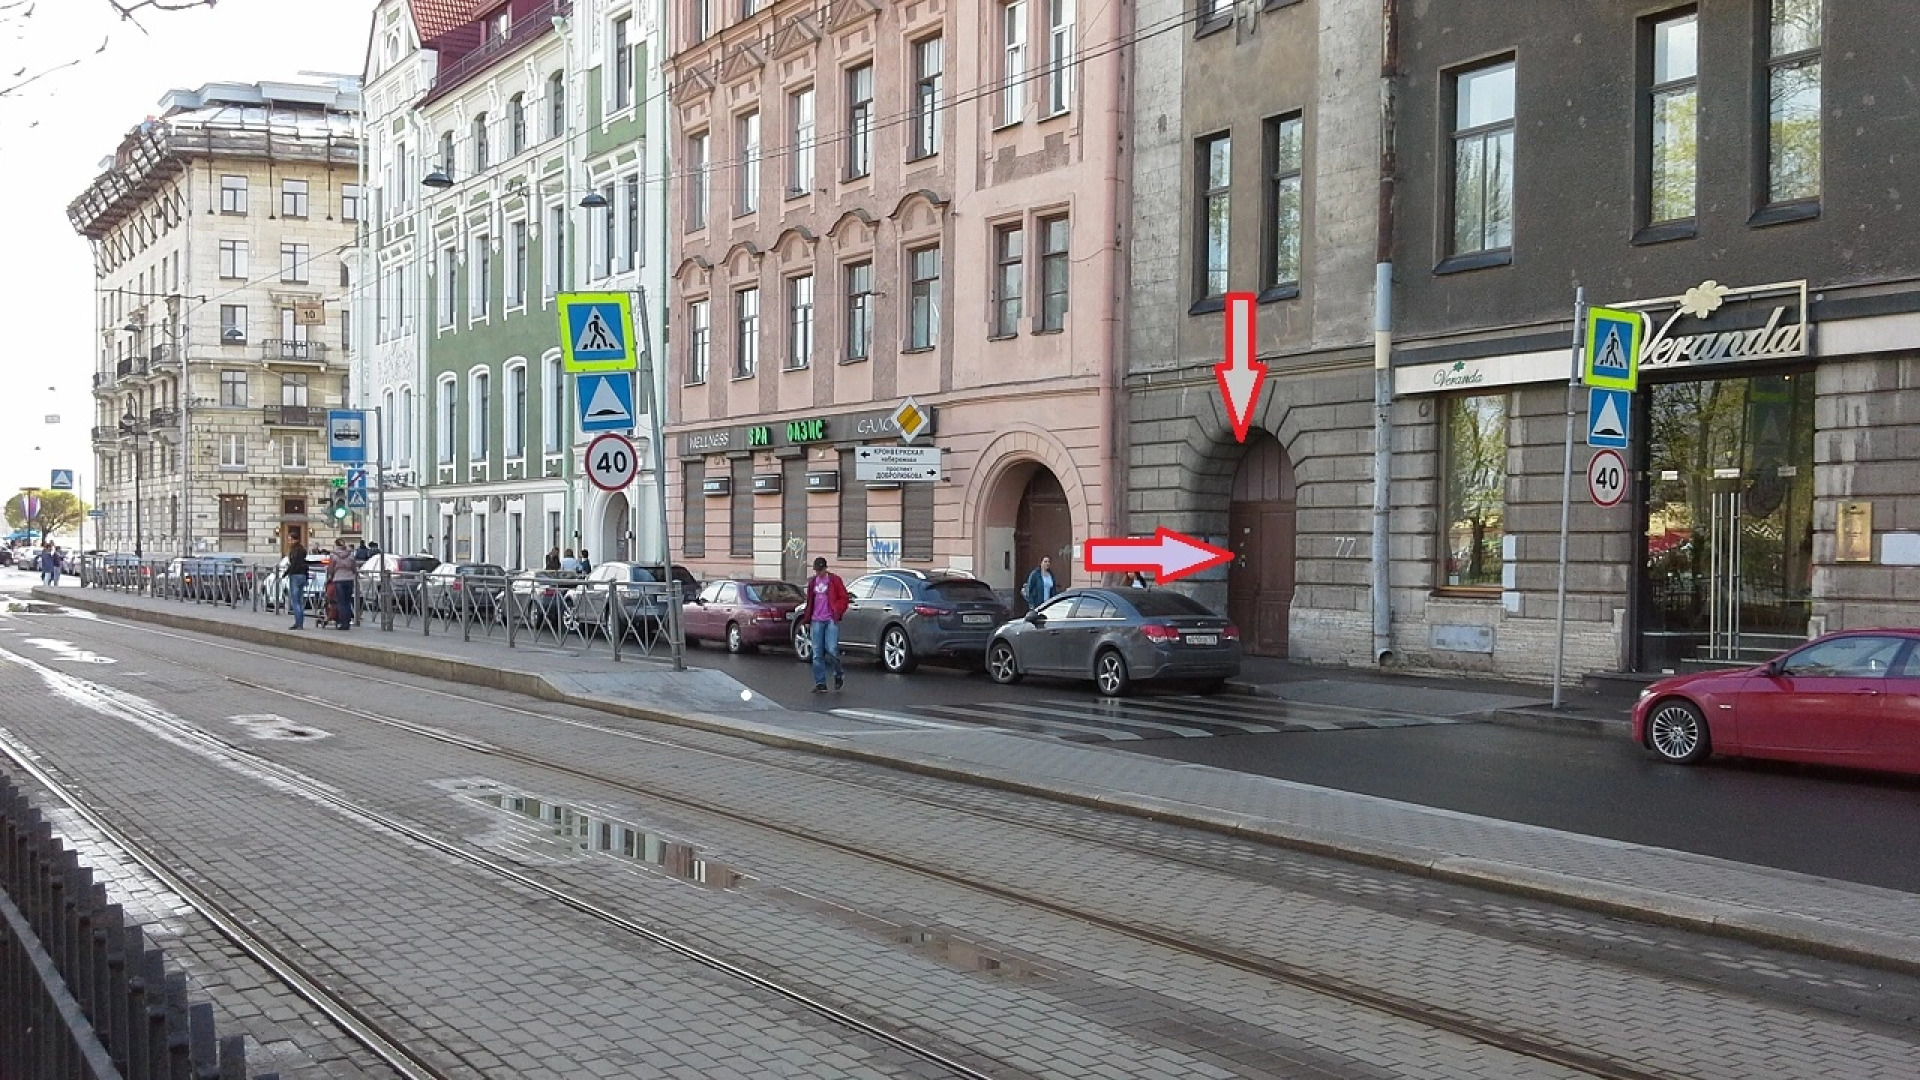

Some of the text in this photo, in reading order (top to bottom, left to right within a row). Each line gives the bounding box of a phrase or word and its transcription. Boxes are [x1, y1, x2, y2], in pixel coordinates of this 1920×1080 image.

[303, 310, 316, 319] 10
[1639, 305, 1801, 365] Veranda
[1433, 368, 1483, 387] Veranda
[748, 426, 768, 445] SPA
[787, 420, 823, 442] ОАЗИС
[857, 417, 894, 434] САЛО
[690, 432, 729, 449] WELLNESS
[596, 450, 628, 474] 40
[1595, 467, 1619, 490] 40
[1335, 536, 1357, 558] 77
